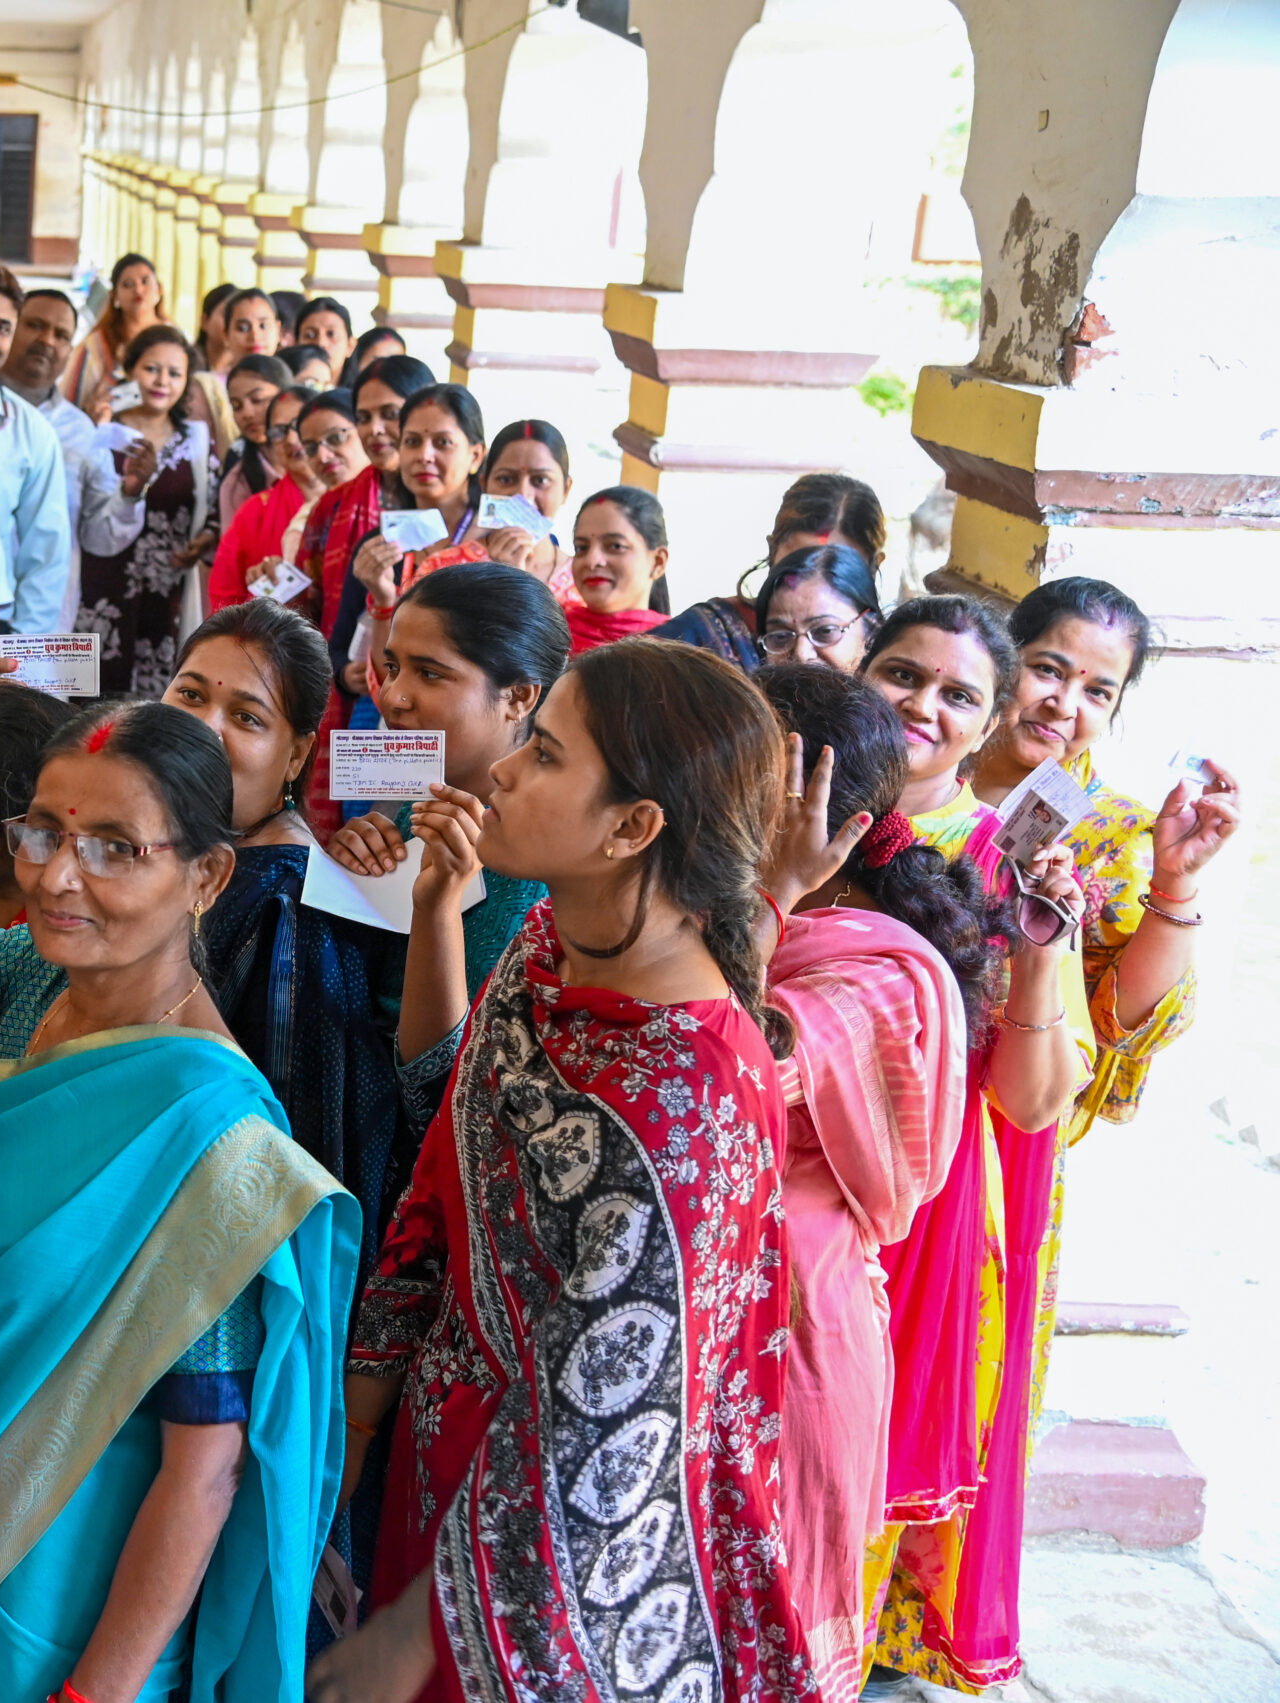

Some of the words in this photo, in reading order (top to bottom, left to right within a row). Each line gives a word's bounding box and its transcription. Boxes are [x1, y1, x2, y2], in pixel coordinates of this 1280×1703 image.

[55, 644, 72, 653] कुमार
[395, 742, 415, 753] कुमार
[416, 741, 438, 750] त्रिपाठी
